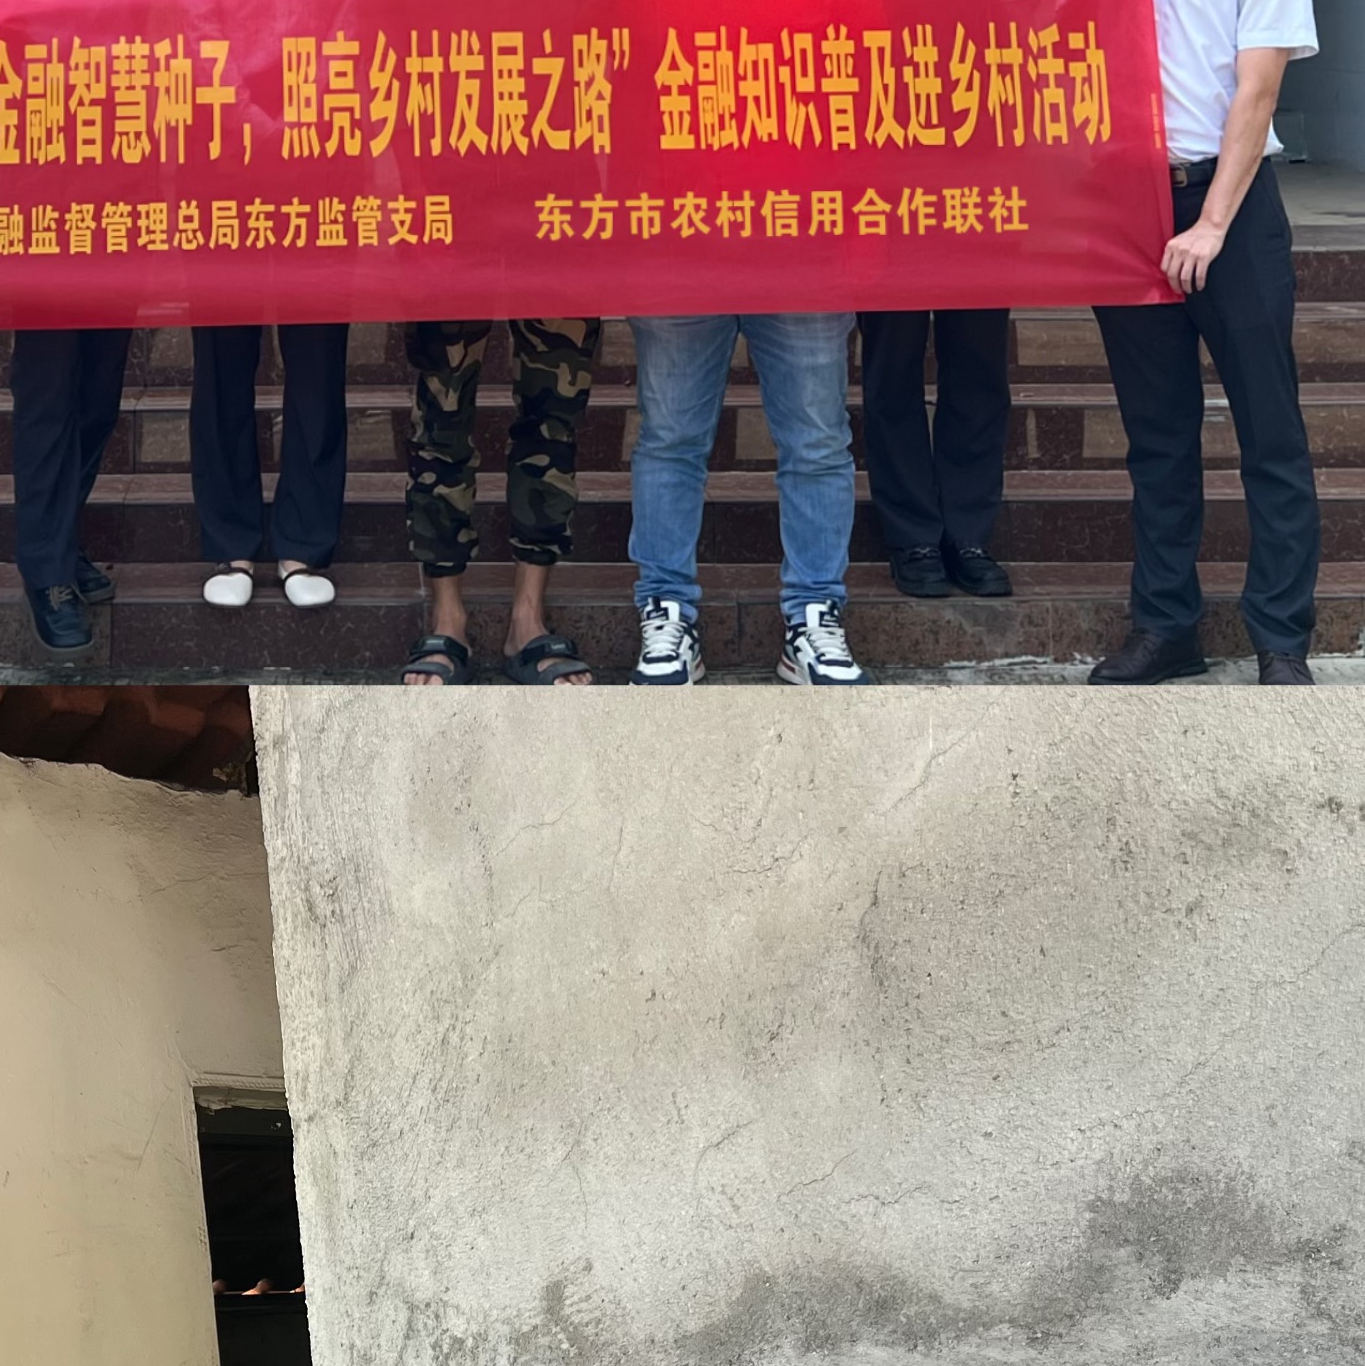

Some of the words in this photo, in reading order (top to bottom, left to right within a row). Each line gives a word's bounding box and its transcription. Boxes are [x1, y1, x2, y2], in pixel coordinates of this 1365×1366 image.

[654, 21, 1112, 153] 金融知识普及进乡村活动
[535, 185, 1029, 241] 东方市农村信用合作联社
